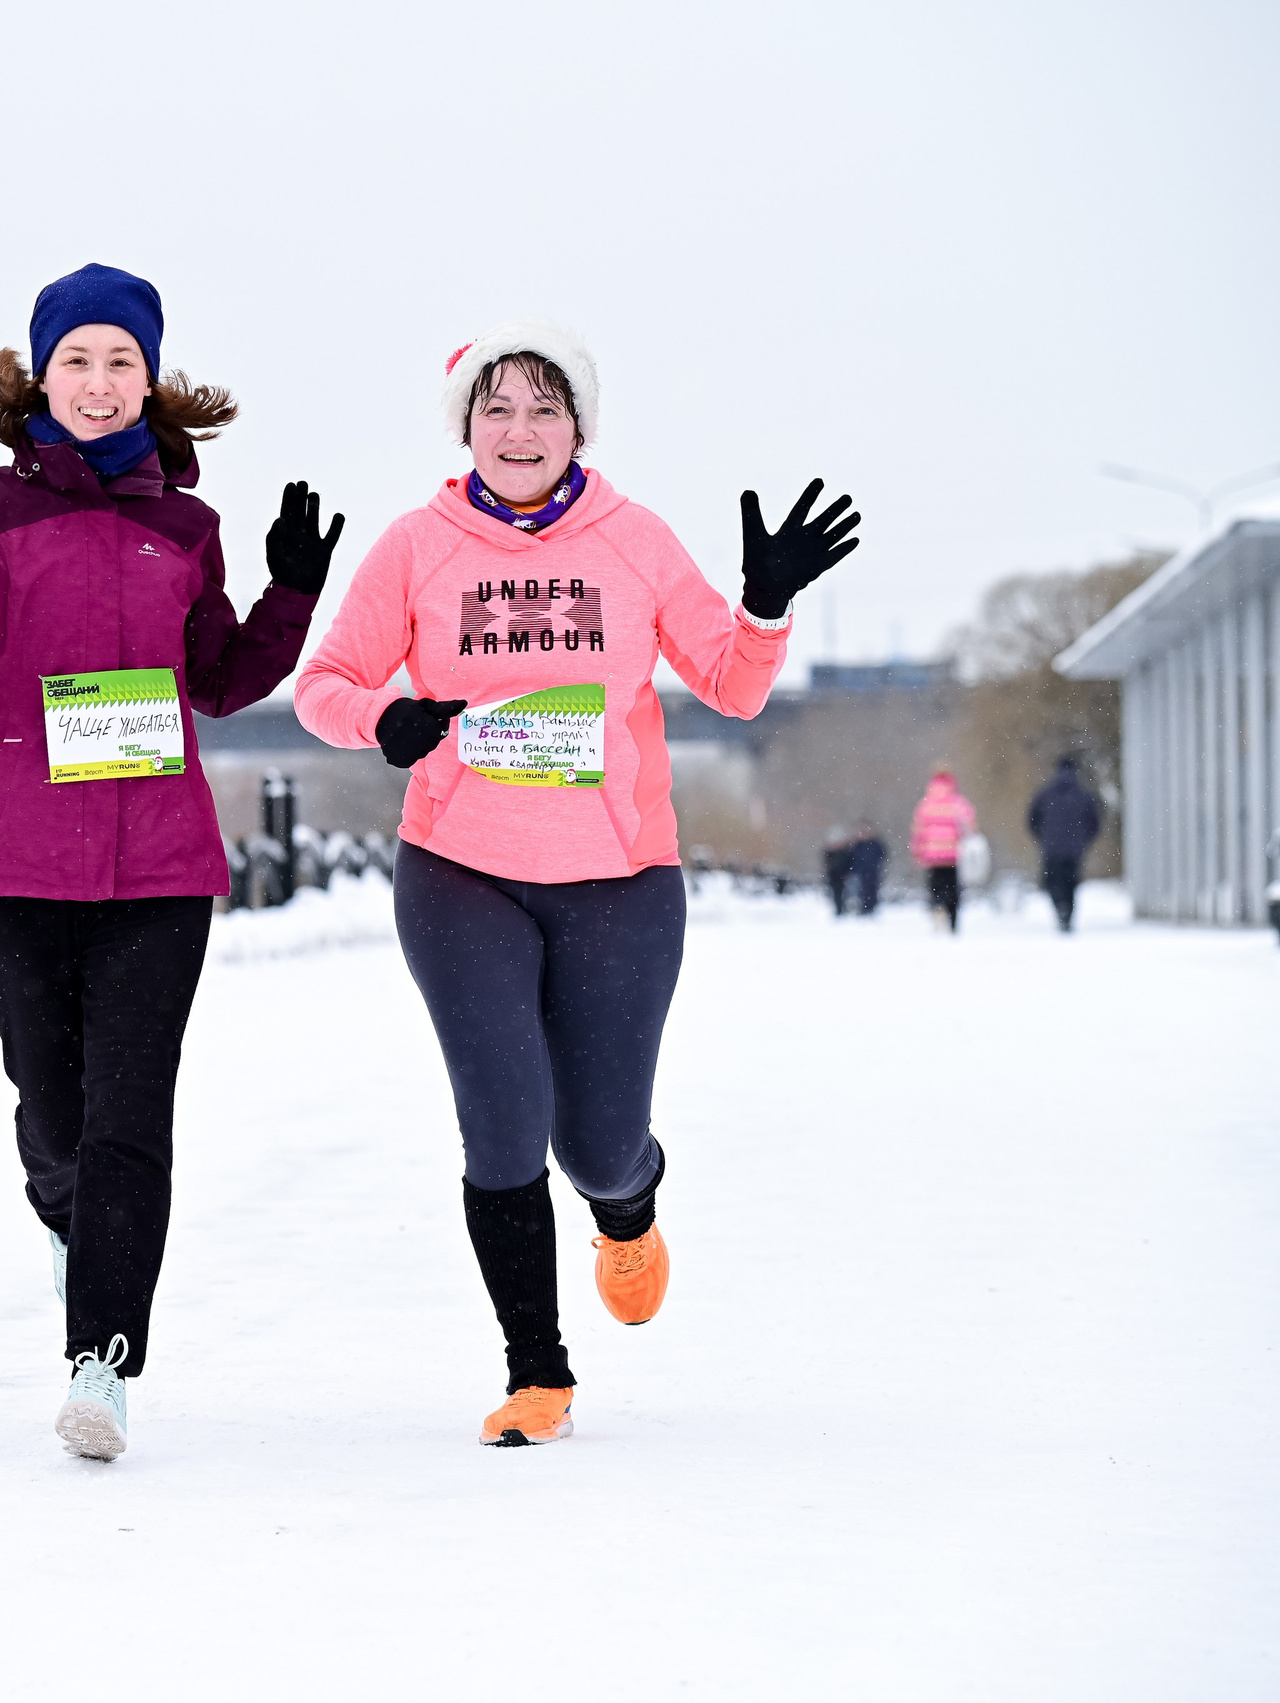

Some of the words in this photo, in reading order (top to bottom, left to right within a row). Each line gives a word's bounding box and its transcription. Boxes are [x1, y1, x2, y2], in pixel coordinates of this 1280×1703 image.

[478, 579, 585, 602] UNDER
[459, 630, 605, 656] ARMOUR
[44, 679, 76, 689] ЗАБЕГ
[47, 683, 100, 698] ОБЕЩАНИЙ
[118, 713, 180, 739] УЛЫБАТЬСЯ
[125, 743, 142, 751] БЕГУ
[533, 754, 552, 762] БЕГУ
